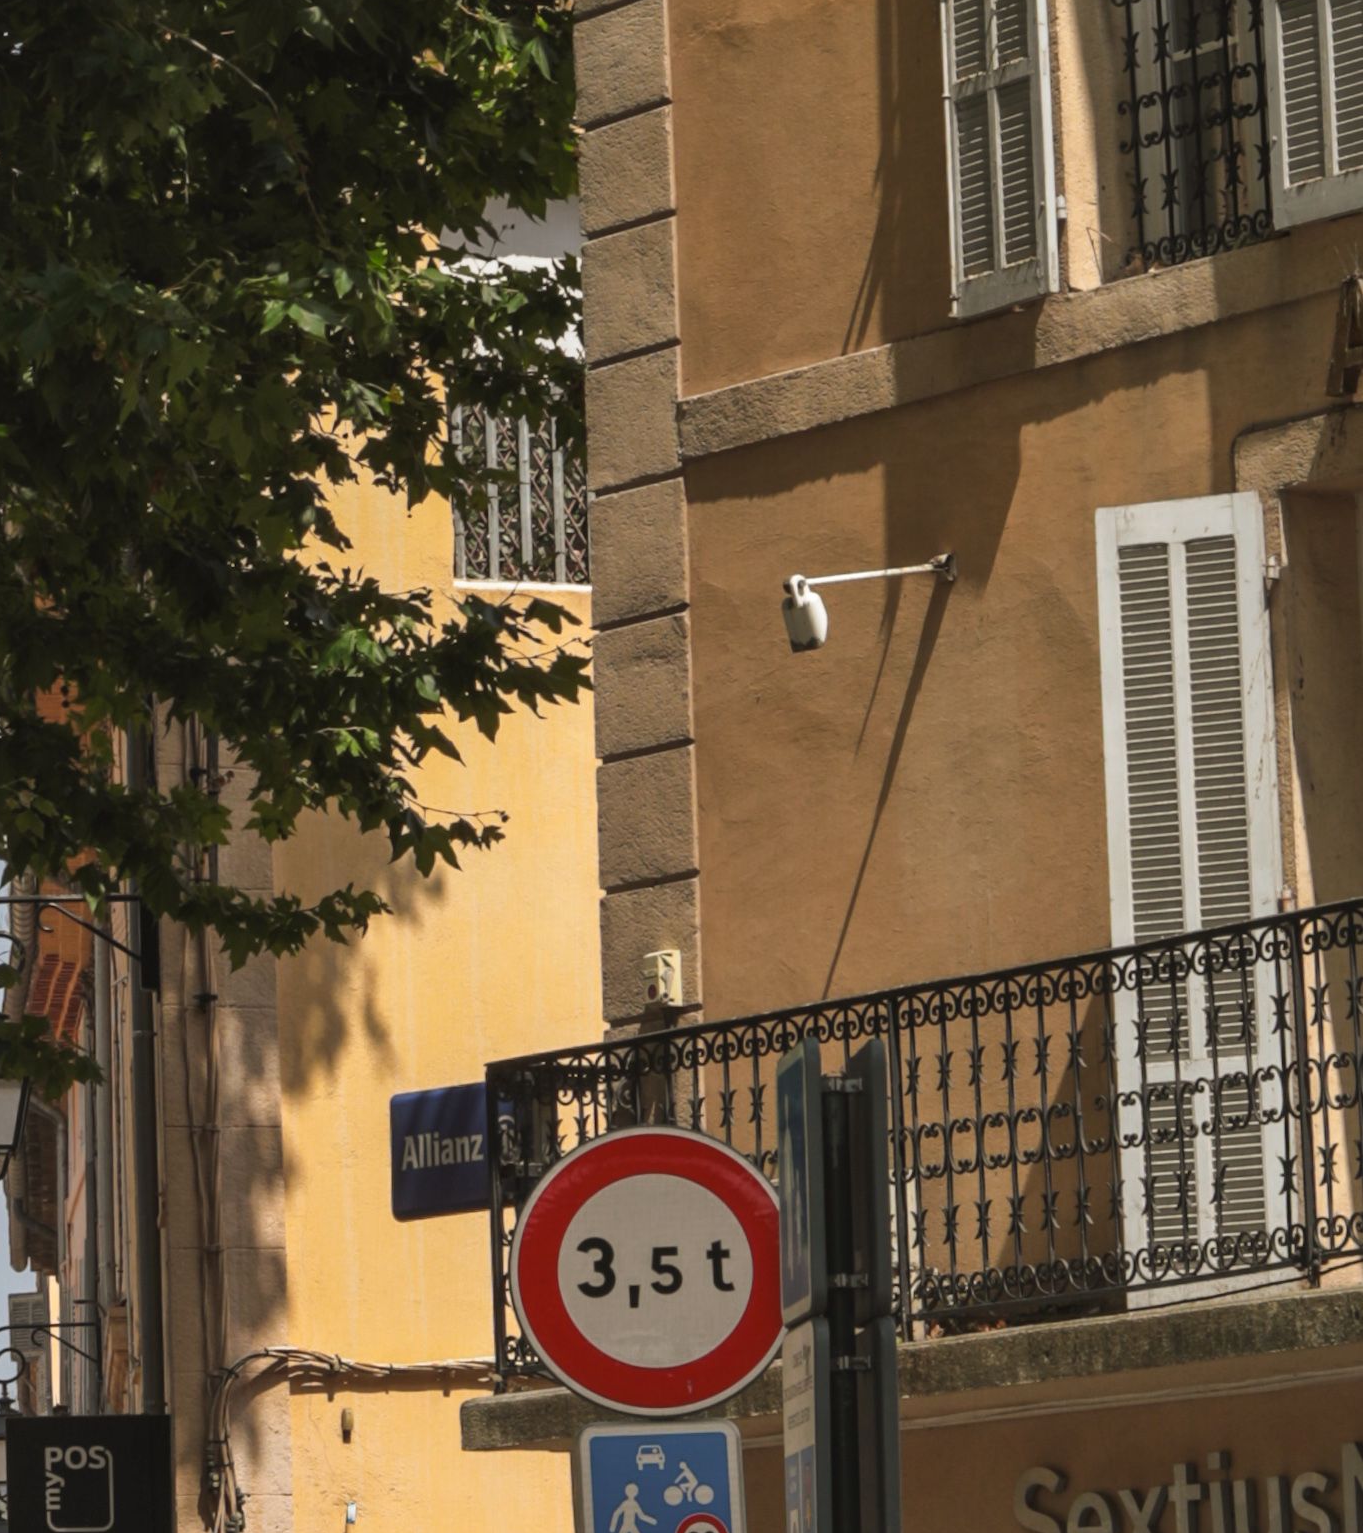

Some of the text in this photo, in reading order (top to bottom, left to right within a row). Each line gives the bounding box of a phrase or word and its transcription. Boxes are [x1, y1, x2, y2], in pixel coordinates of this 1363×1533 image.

[401, 1131, 484, 1171] Allianz
[576, 1237, 735, 1308] 3,5 t
